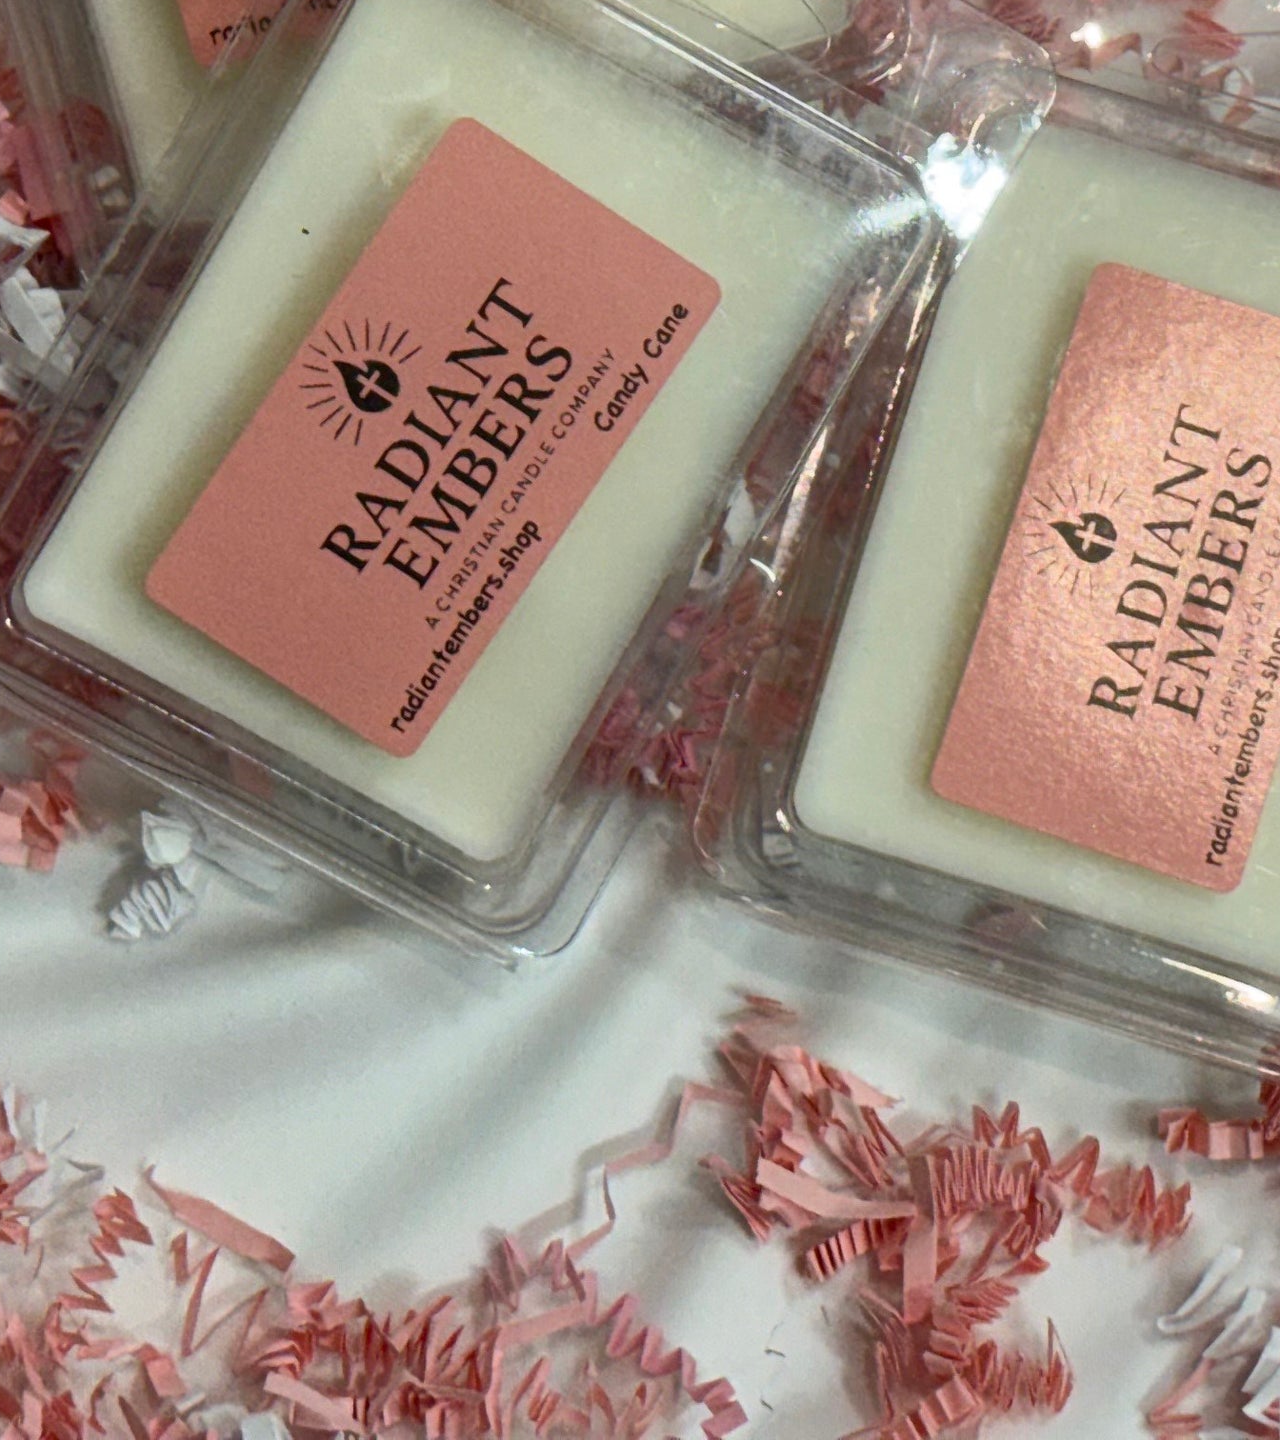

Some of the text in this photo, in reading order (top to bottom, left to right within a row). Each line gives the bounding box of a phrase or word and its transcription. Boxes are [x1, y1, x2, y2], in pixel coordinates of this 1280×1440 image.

[320, 277, 533, 574] RADIANT
[383, 335, 573, 590] EMBERS
[426, 348, 615, 630] A CHRISTIAN CANDLE COMPANY
[594, 302, 689, 433] Candy Cane
[391, 521, 543, 734] radiantembers.shop
[1087, 404, 1221, 719] RADIANT
[1153, 447, 1272, 722] EMBERS
[1208, 742, 1220, 756] A
